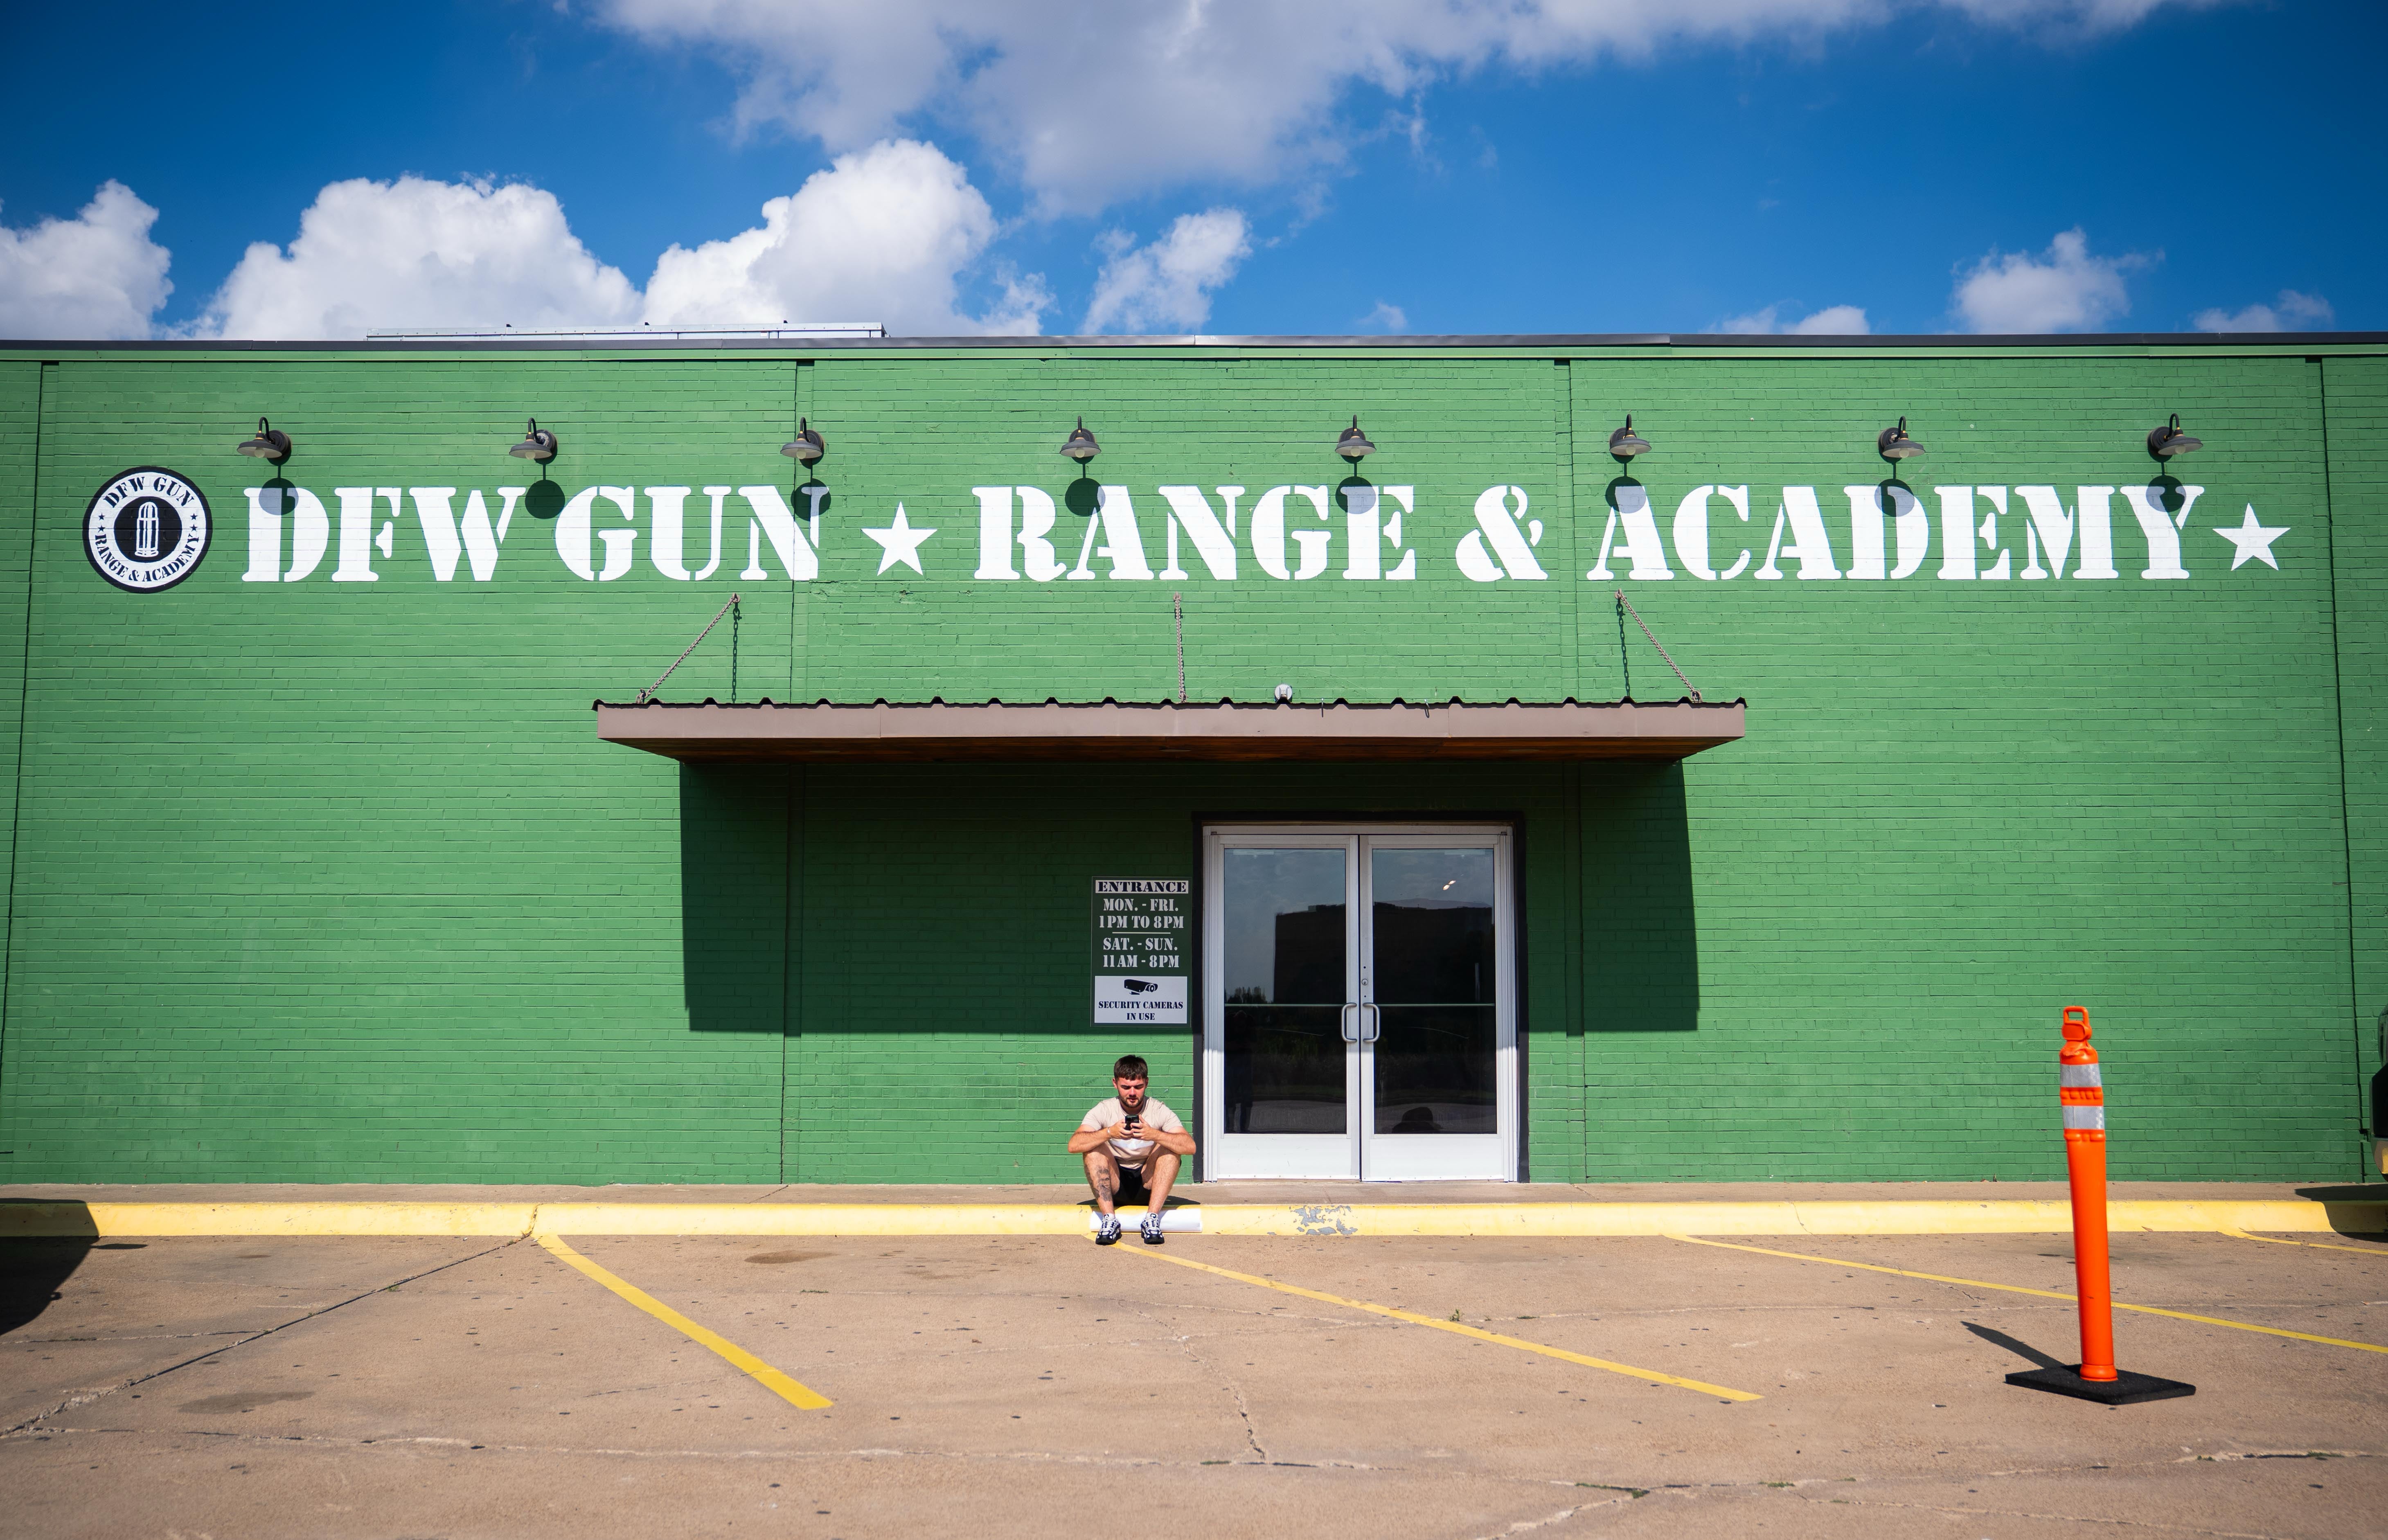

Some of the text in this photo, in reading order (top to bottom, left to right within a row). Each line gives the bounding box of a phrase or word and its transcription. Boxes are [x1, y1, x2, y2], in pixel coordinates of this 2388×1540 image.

[104, 477, 194, 508] DFW GUN
[242, 485, 2205, 582] DFW GUN RANGE & ACADEMY
[95, 533, 199, 582] RANGE & ACADEMY
[1098, 881, 1186, 892] ENTRANCE
[1104, 898, 1138, 911] MON.
[1150, 899, 1178, 911] FRI.
[1132, 916, 1149, 928] TO
[1103, 937, 1133, 950] SAT.
[1146, 938, 1178, 950] SUN.
